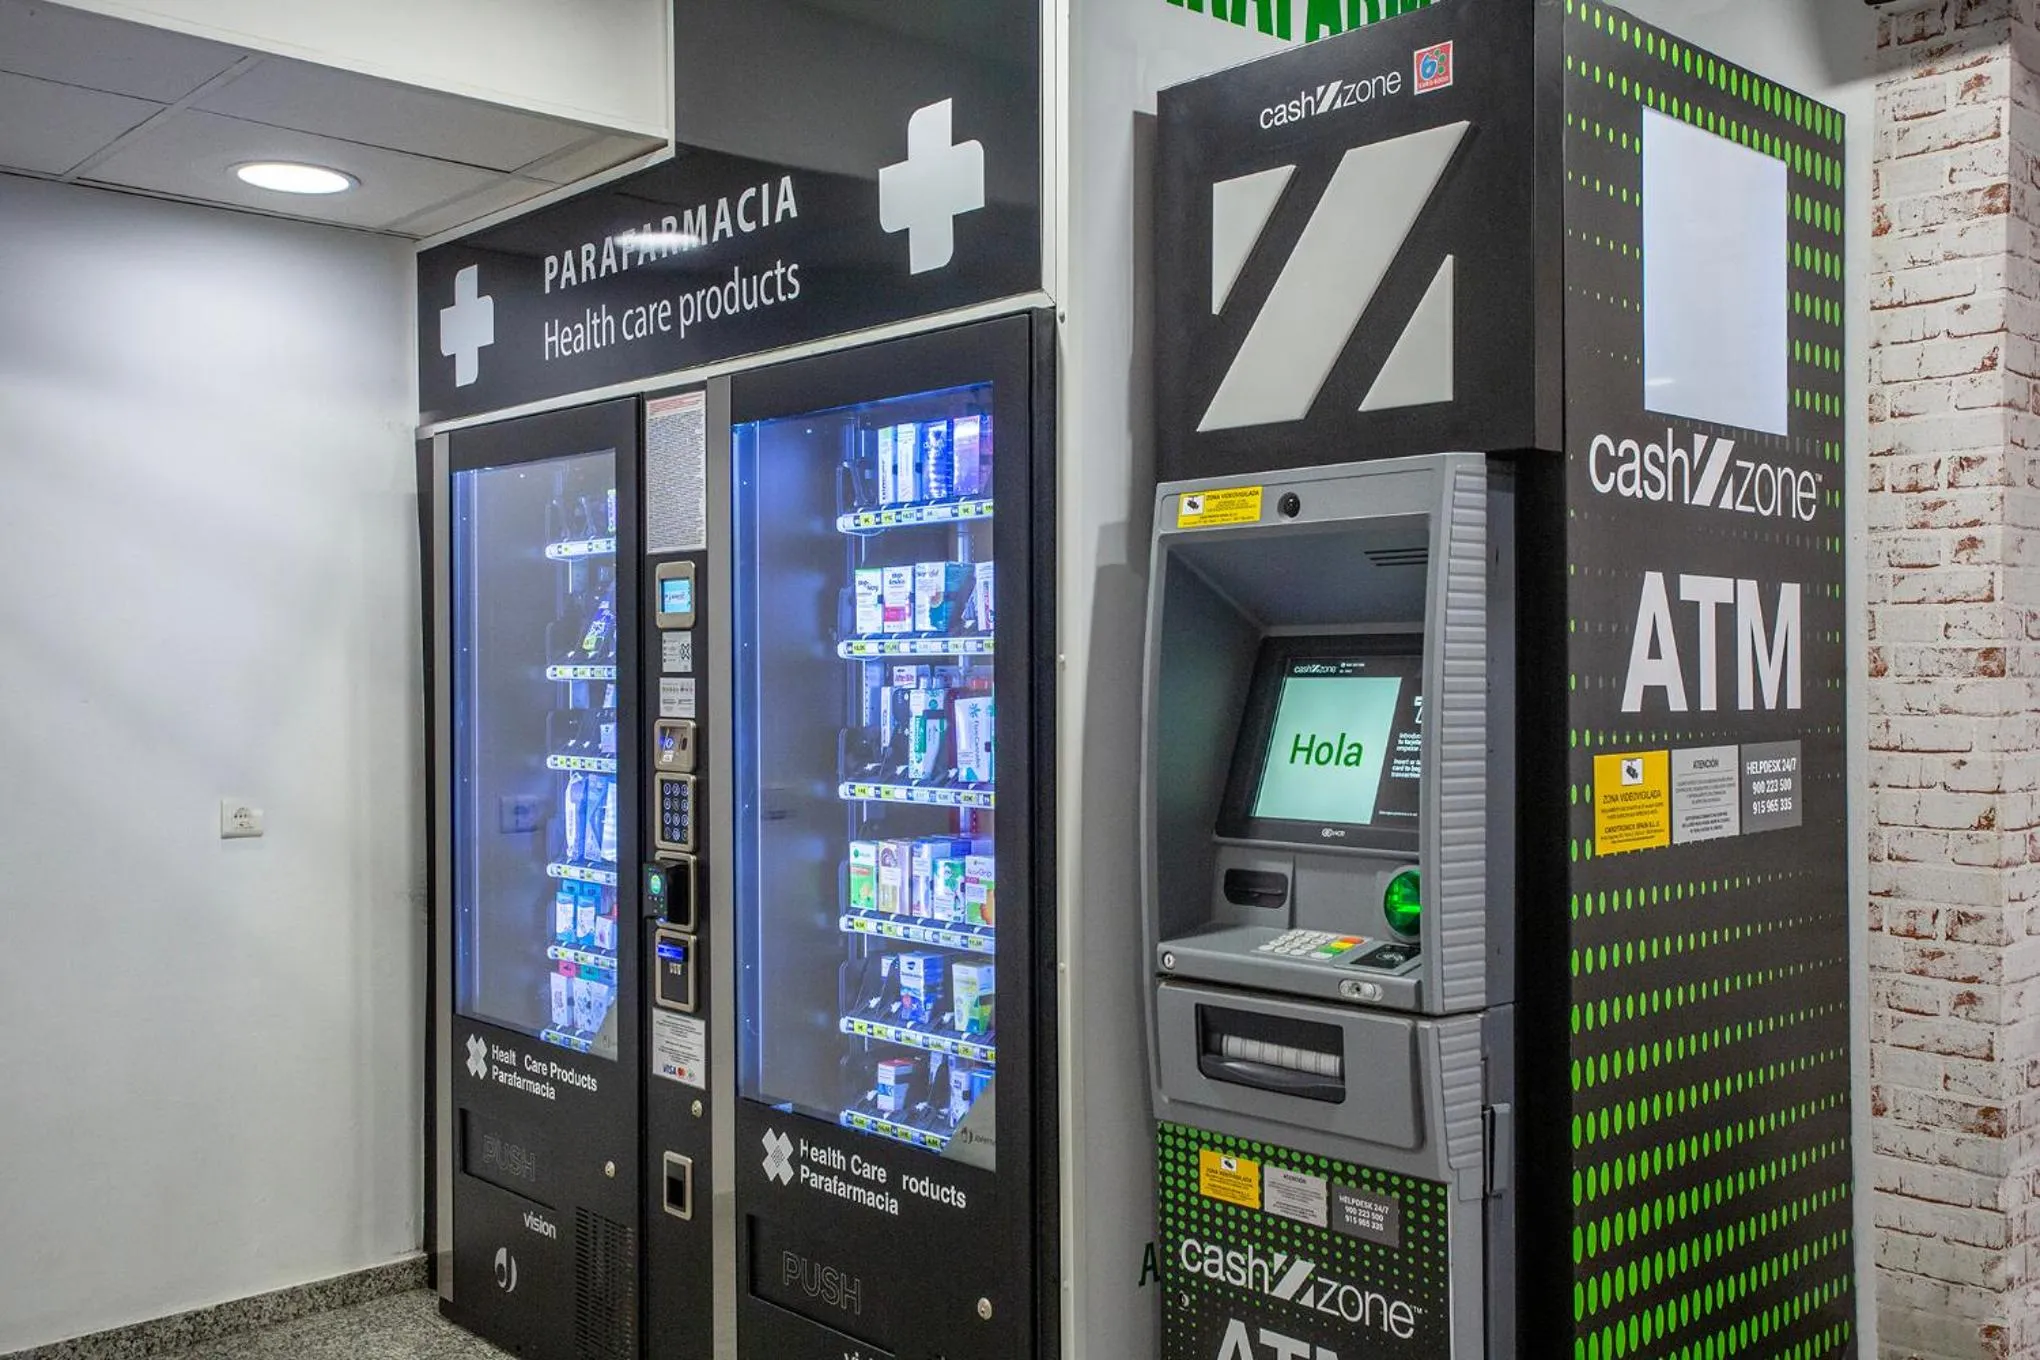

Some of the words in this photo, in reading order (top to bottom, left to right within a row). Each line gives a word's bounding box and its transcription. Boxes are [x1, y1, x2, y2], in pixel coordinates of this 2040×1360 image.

[544, 175, 798, 294] PARAFARMACIA
[545, 308, 615, 361] Health
[622, 299, 671, 341] care
[680, 259, 800, 339] products
[1621, 571, 1801, 712] ATM
[1289, 732, 1364, 767] Hola
[1746, 759, 1780, 775] HELPDESK
[1781, 757, 1797, 772] 24/7
[1752, 781, 1765, 795] 900
[1766, 779, 1779, 794] 223
[1779, 778, 1792, 792] 500
[1752, 801, 1766, 815] 915
[1767, 799, 1779, 813] 965
[1779, 798, 1792, 812] 335
[492, 1065, 556, 1100] Parafarmacia
[524, 1054, 548, 1075] Care
[550, 1061, 598, 1092] Products
[483, 1134, 535, 1181] PUSH
[851, 1154, 887, 1183] Care
[800, 1164, 899, 1215] Parafarmacia
[1339, 1195, 1373, 1210] HELPDESK
[523, 1210, 556, 1240] vision
[783, 1250, 861, 1315] PUSH
